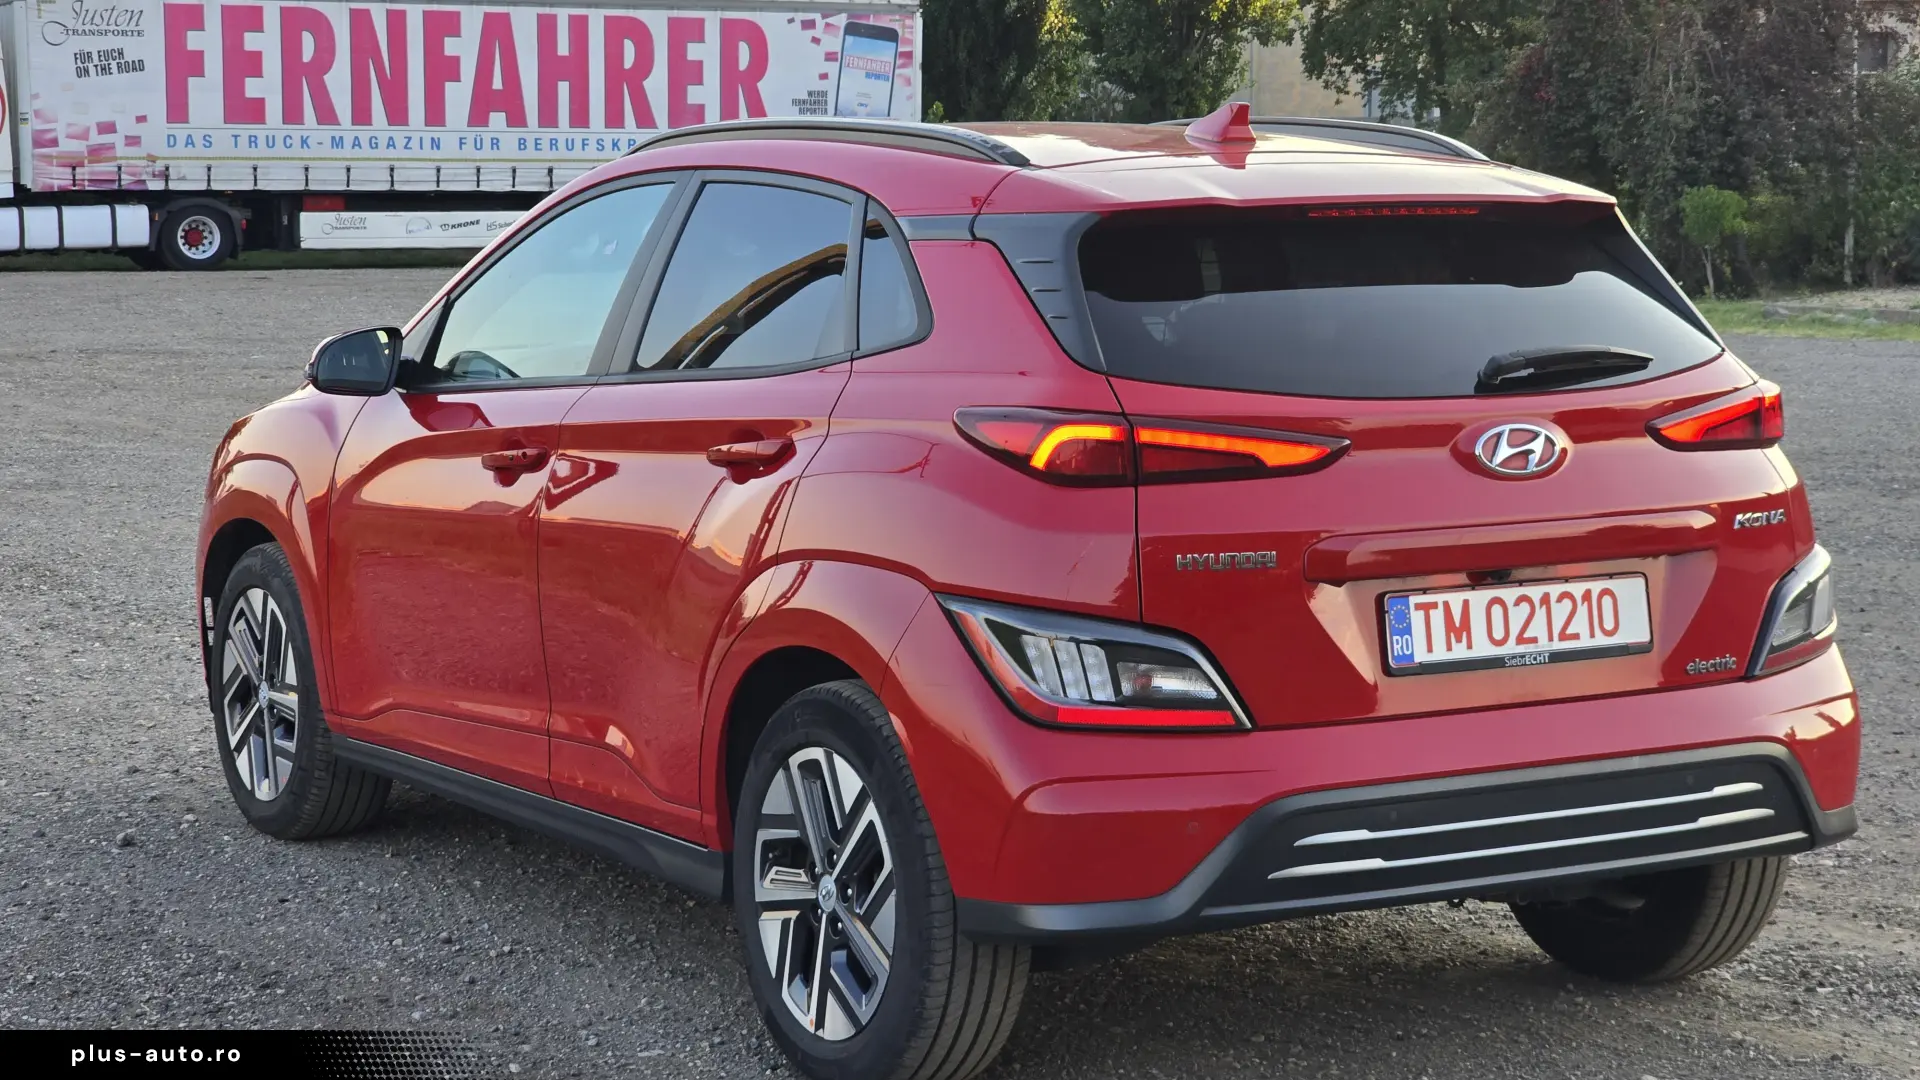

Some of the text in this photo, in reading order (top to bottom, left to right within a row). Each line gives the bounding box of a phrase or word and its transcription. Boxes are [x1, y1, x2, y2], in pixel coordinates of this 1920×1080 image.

[62, 0, 144, 31] Justen
[73, 47, 125, 65] FÜR EUCH
[163, 2, 769, 129] FERNFAHRER
[844, 55, 891, 74] FERNFAHRER
[75, 59, 146, 79] ON THE ROAD
[791, 98, 829, 107] FERNFAHRER
[806, 90, 829, 99] WERDE
[798, 107, 829, 116] REPORTER
[166, 133, 214, 150] DAS
[232, 134, 442, 152] TRUCK-MAGAZIN
[458, 134, 500, 151] FÜR
[333, 213, 367, 226] Justen
[450, 219, 481, 230] KRONE
[1733, 508, 1786, 530] KONA
[1176, 551, 1277, 571] HYUNDAI
[1414, 586, 1620, 654] TM 021210
[1393, 635, 1412, 656] RO
[1504, 652, 1551, 668] SiebrECHT
[1686, 653, 1738, 675] electric
